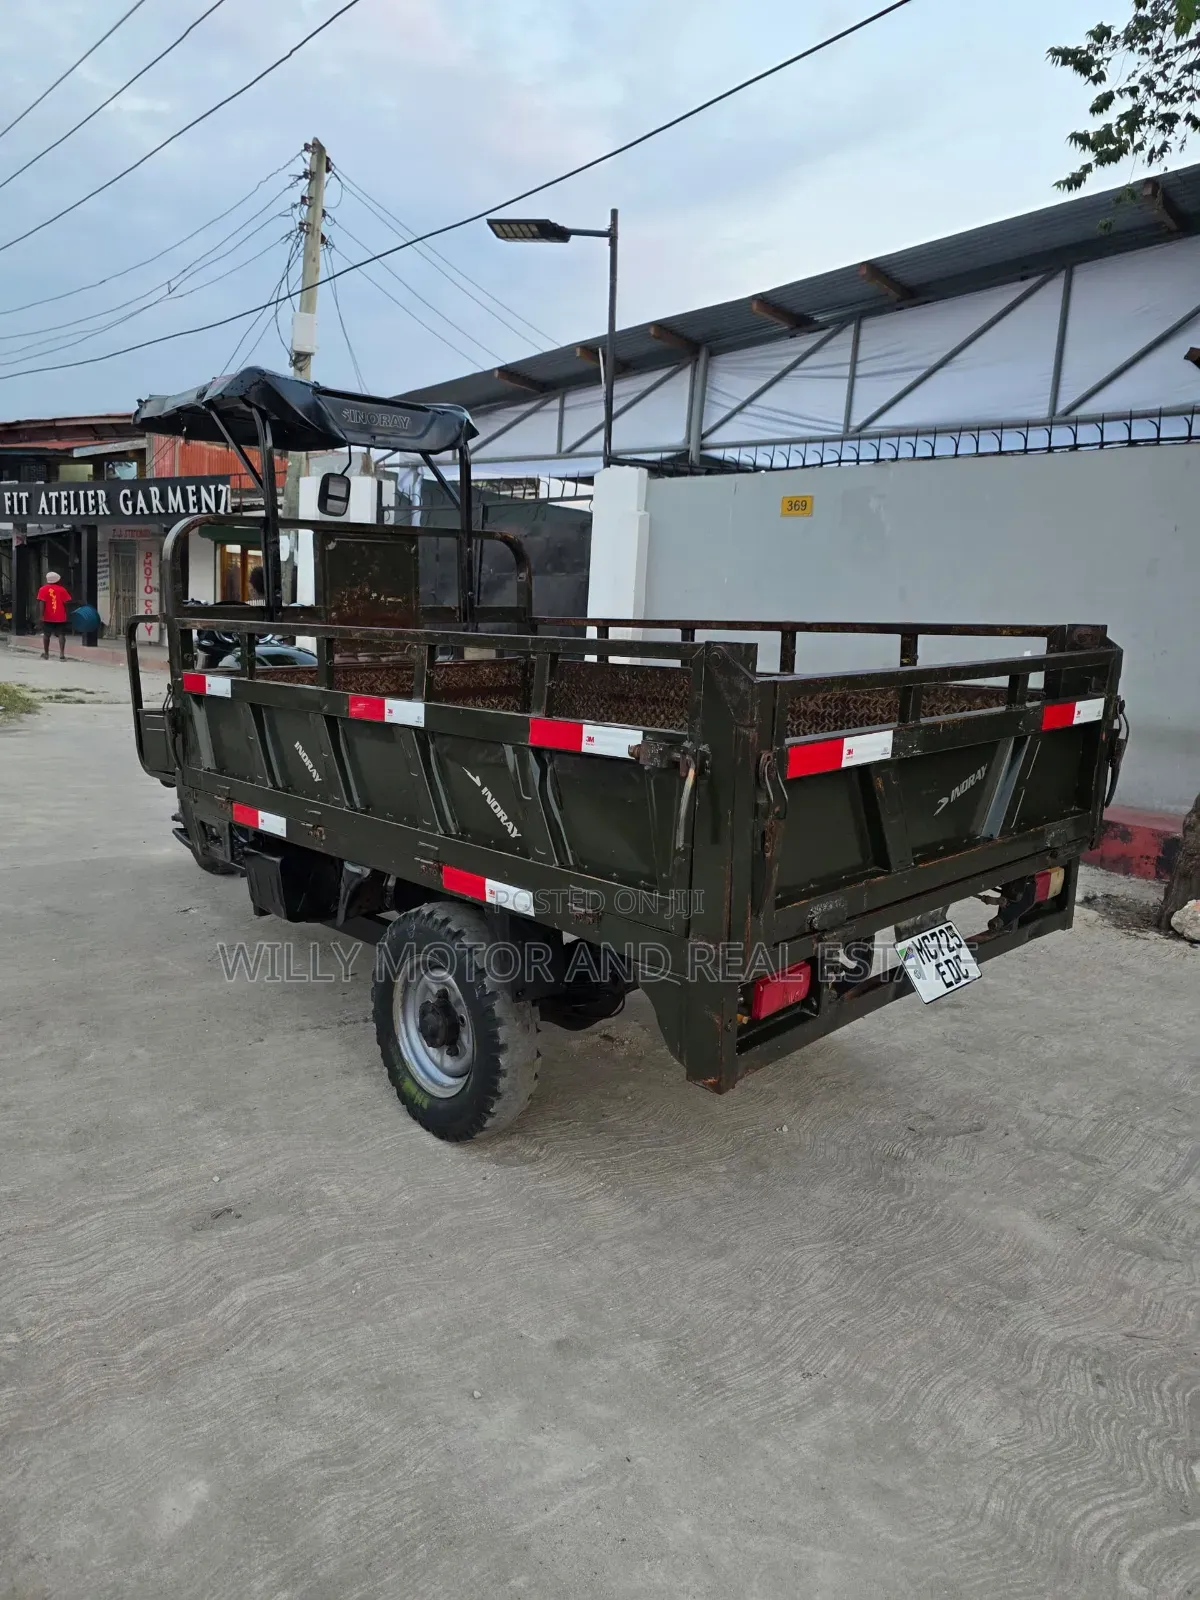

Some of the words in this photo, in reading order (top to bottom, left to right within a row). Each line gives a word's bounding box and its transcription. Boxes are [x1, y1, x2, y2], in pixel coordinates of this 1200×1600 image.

[341, 408, 410, 430] SINORAY
[4, 491, 29, 515] FIT
[38, 490, 110, 515] ATELIER
[786, 499, 808, 511] 369
[143, 551, 153, 595] PHOTO
[144, 599, 153, 637] COY
[585, 735, 595, 744] 3M
[911, 925, 963, 965] MC725
[934, 954, 970, 989] EDC
